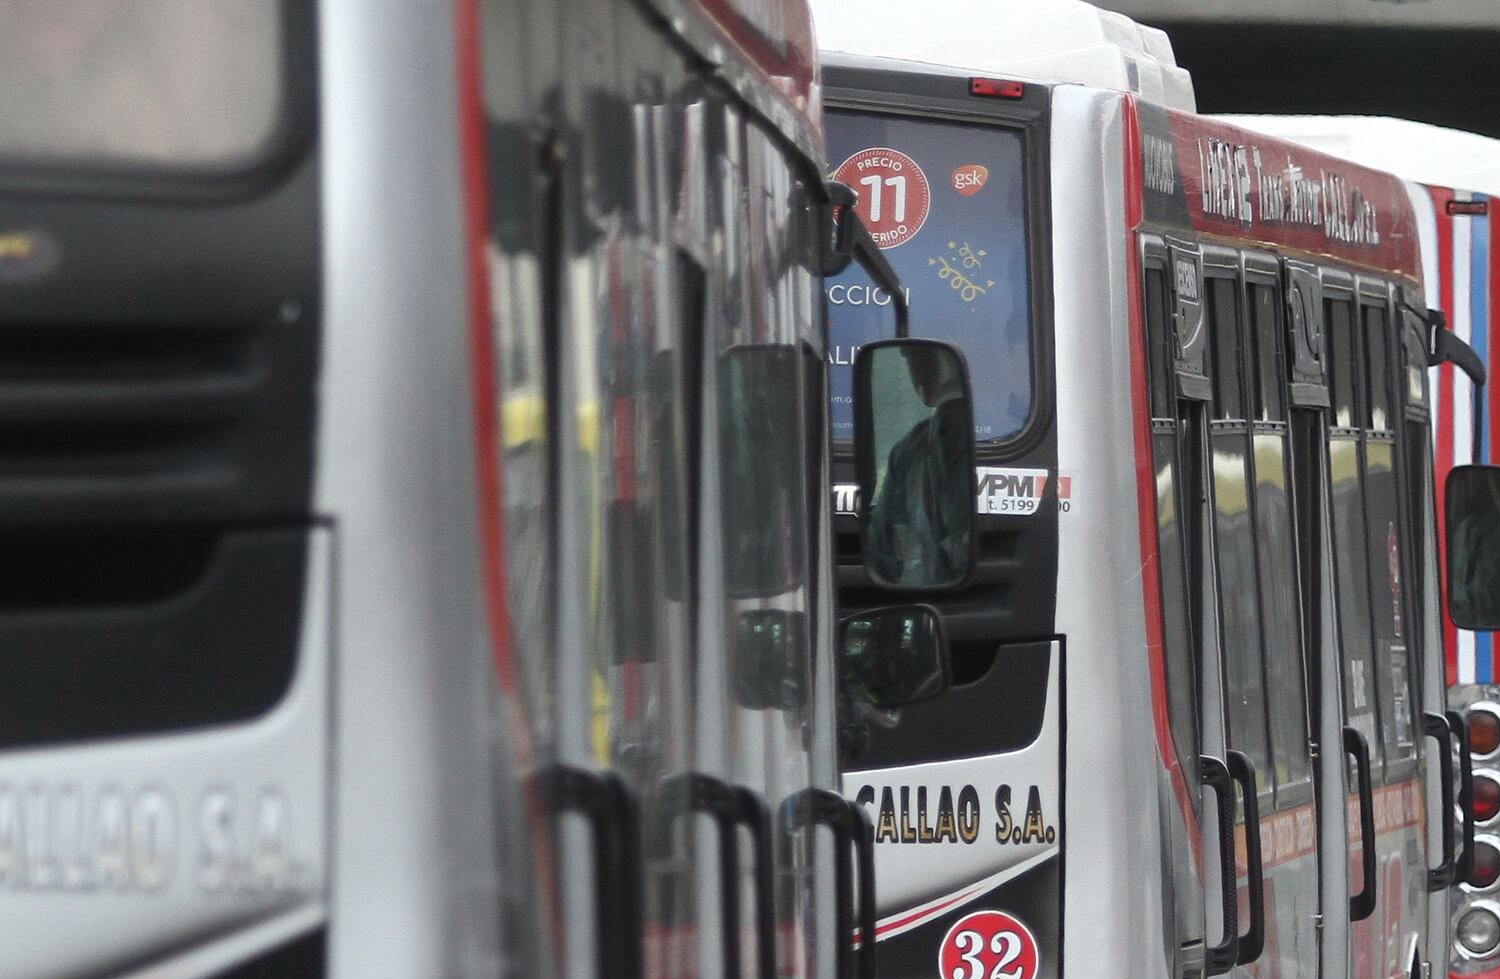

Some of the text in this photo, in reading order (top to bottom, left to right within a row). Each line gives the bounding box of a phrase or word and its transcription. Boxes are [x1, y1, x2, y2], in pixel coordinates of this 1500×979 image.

[857, 157, 902, 172] PRECIO
[955, 172, 983, 189] gsk
[1001, 500, 1034, 511] 5199
[995, 784, 1055, 845] S.A.
